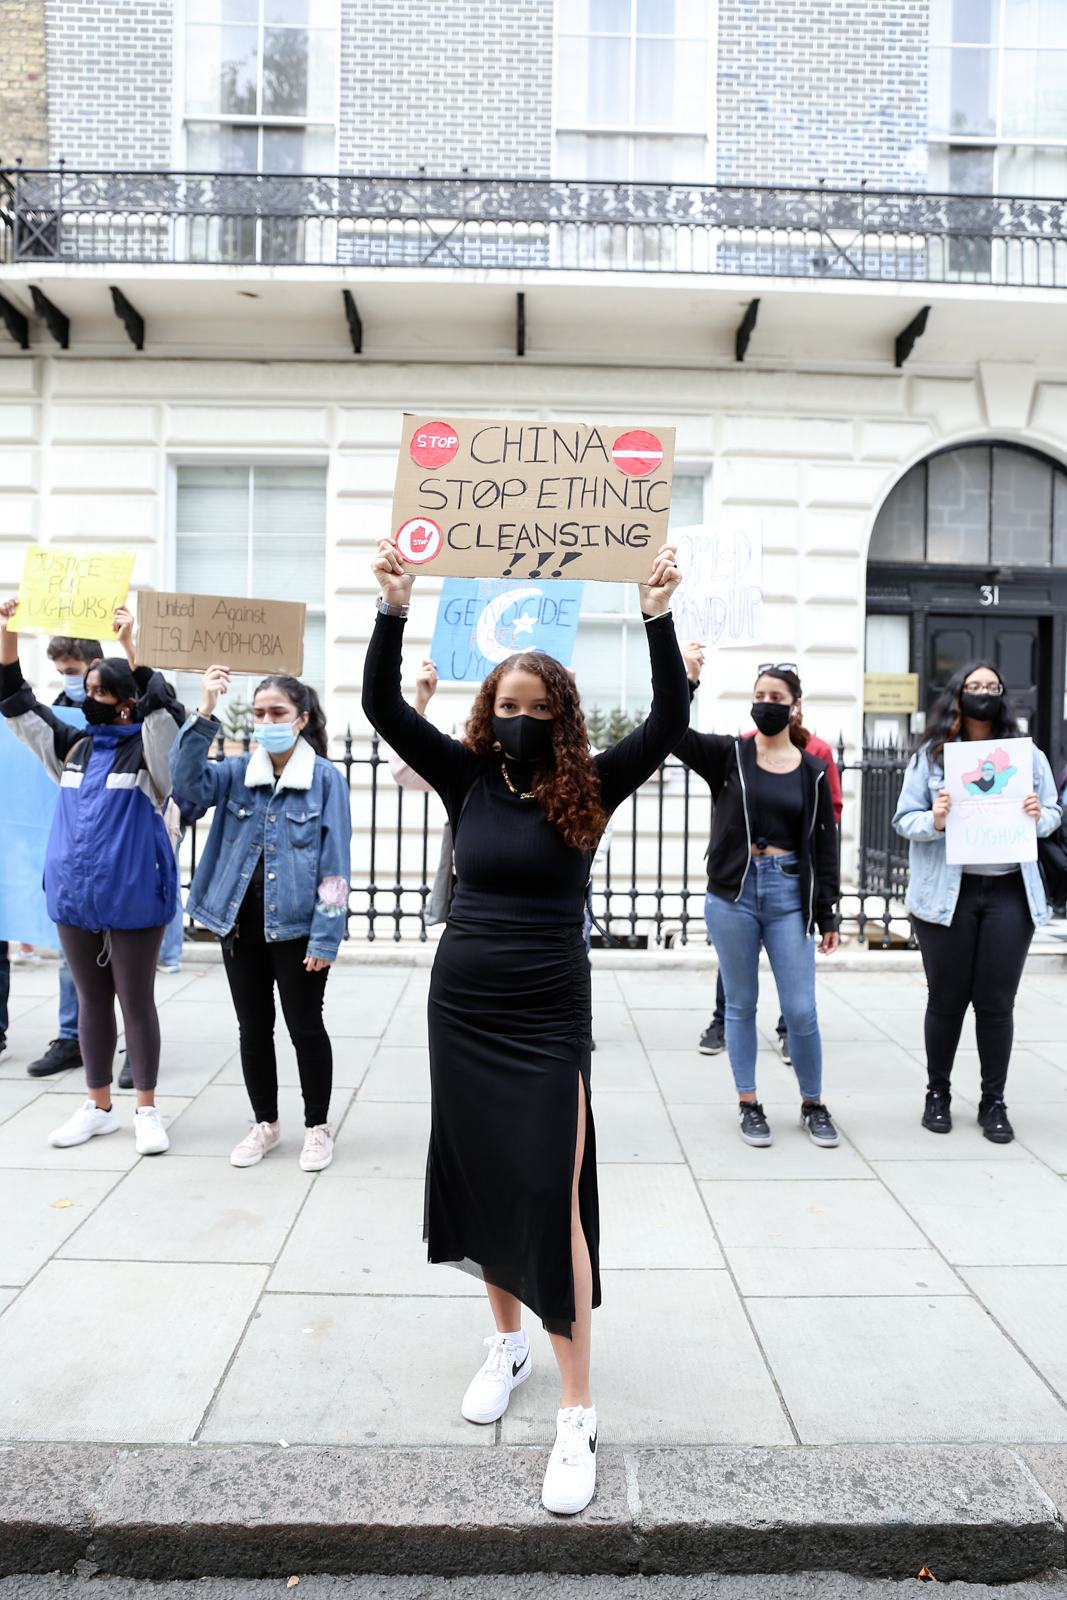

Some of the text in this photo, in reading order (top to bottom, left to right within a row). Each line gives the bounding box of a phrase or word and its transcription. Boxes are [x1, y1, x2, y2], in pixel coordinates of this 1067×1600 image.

[417, 434, 457, 448] STOP
[470, 426, 610, 465] CHINA
[536, 476, 669, 513] ETHNIC
[447, 522, 651, 553] CLEANSING
[48, 575, 81, 594] FOR
[478, 580, 534, 599] STOP
[979, 585, 999, 605] 31
[157, 598, 267, 630] United Against
[444, 597, 576, 627] GENOCIDE
[152, 626, 284, 656] ISLAMOPHOBIA
[470, 628, 521, 649] FREE
[955, 795, 1004, 820] SAVE
[965, 824, 1030, 846] UYGHUR
